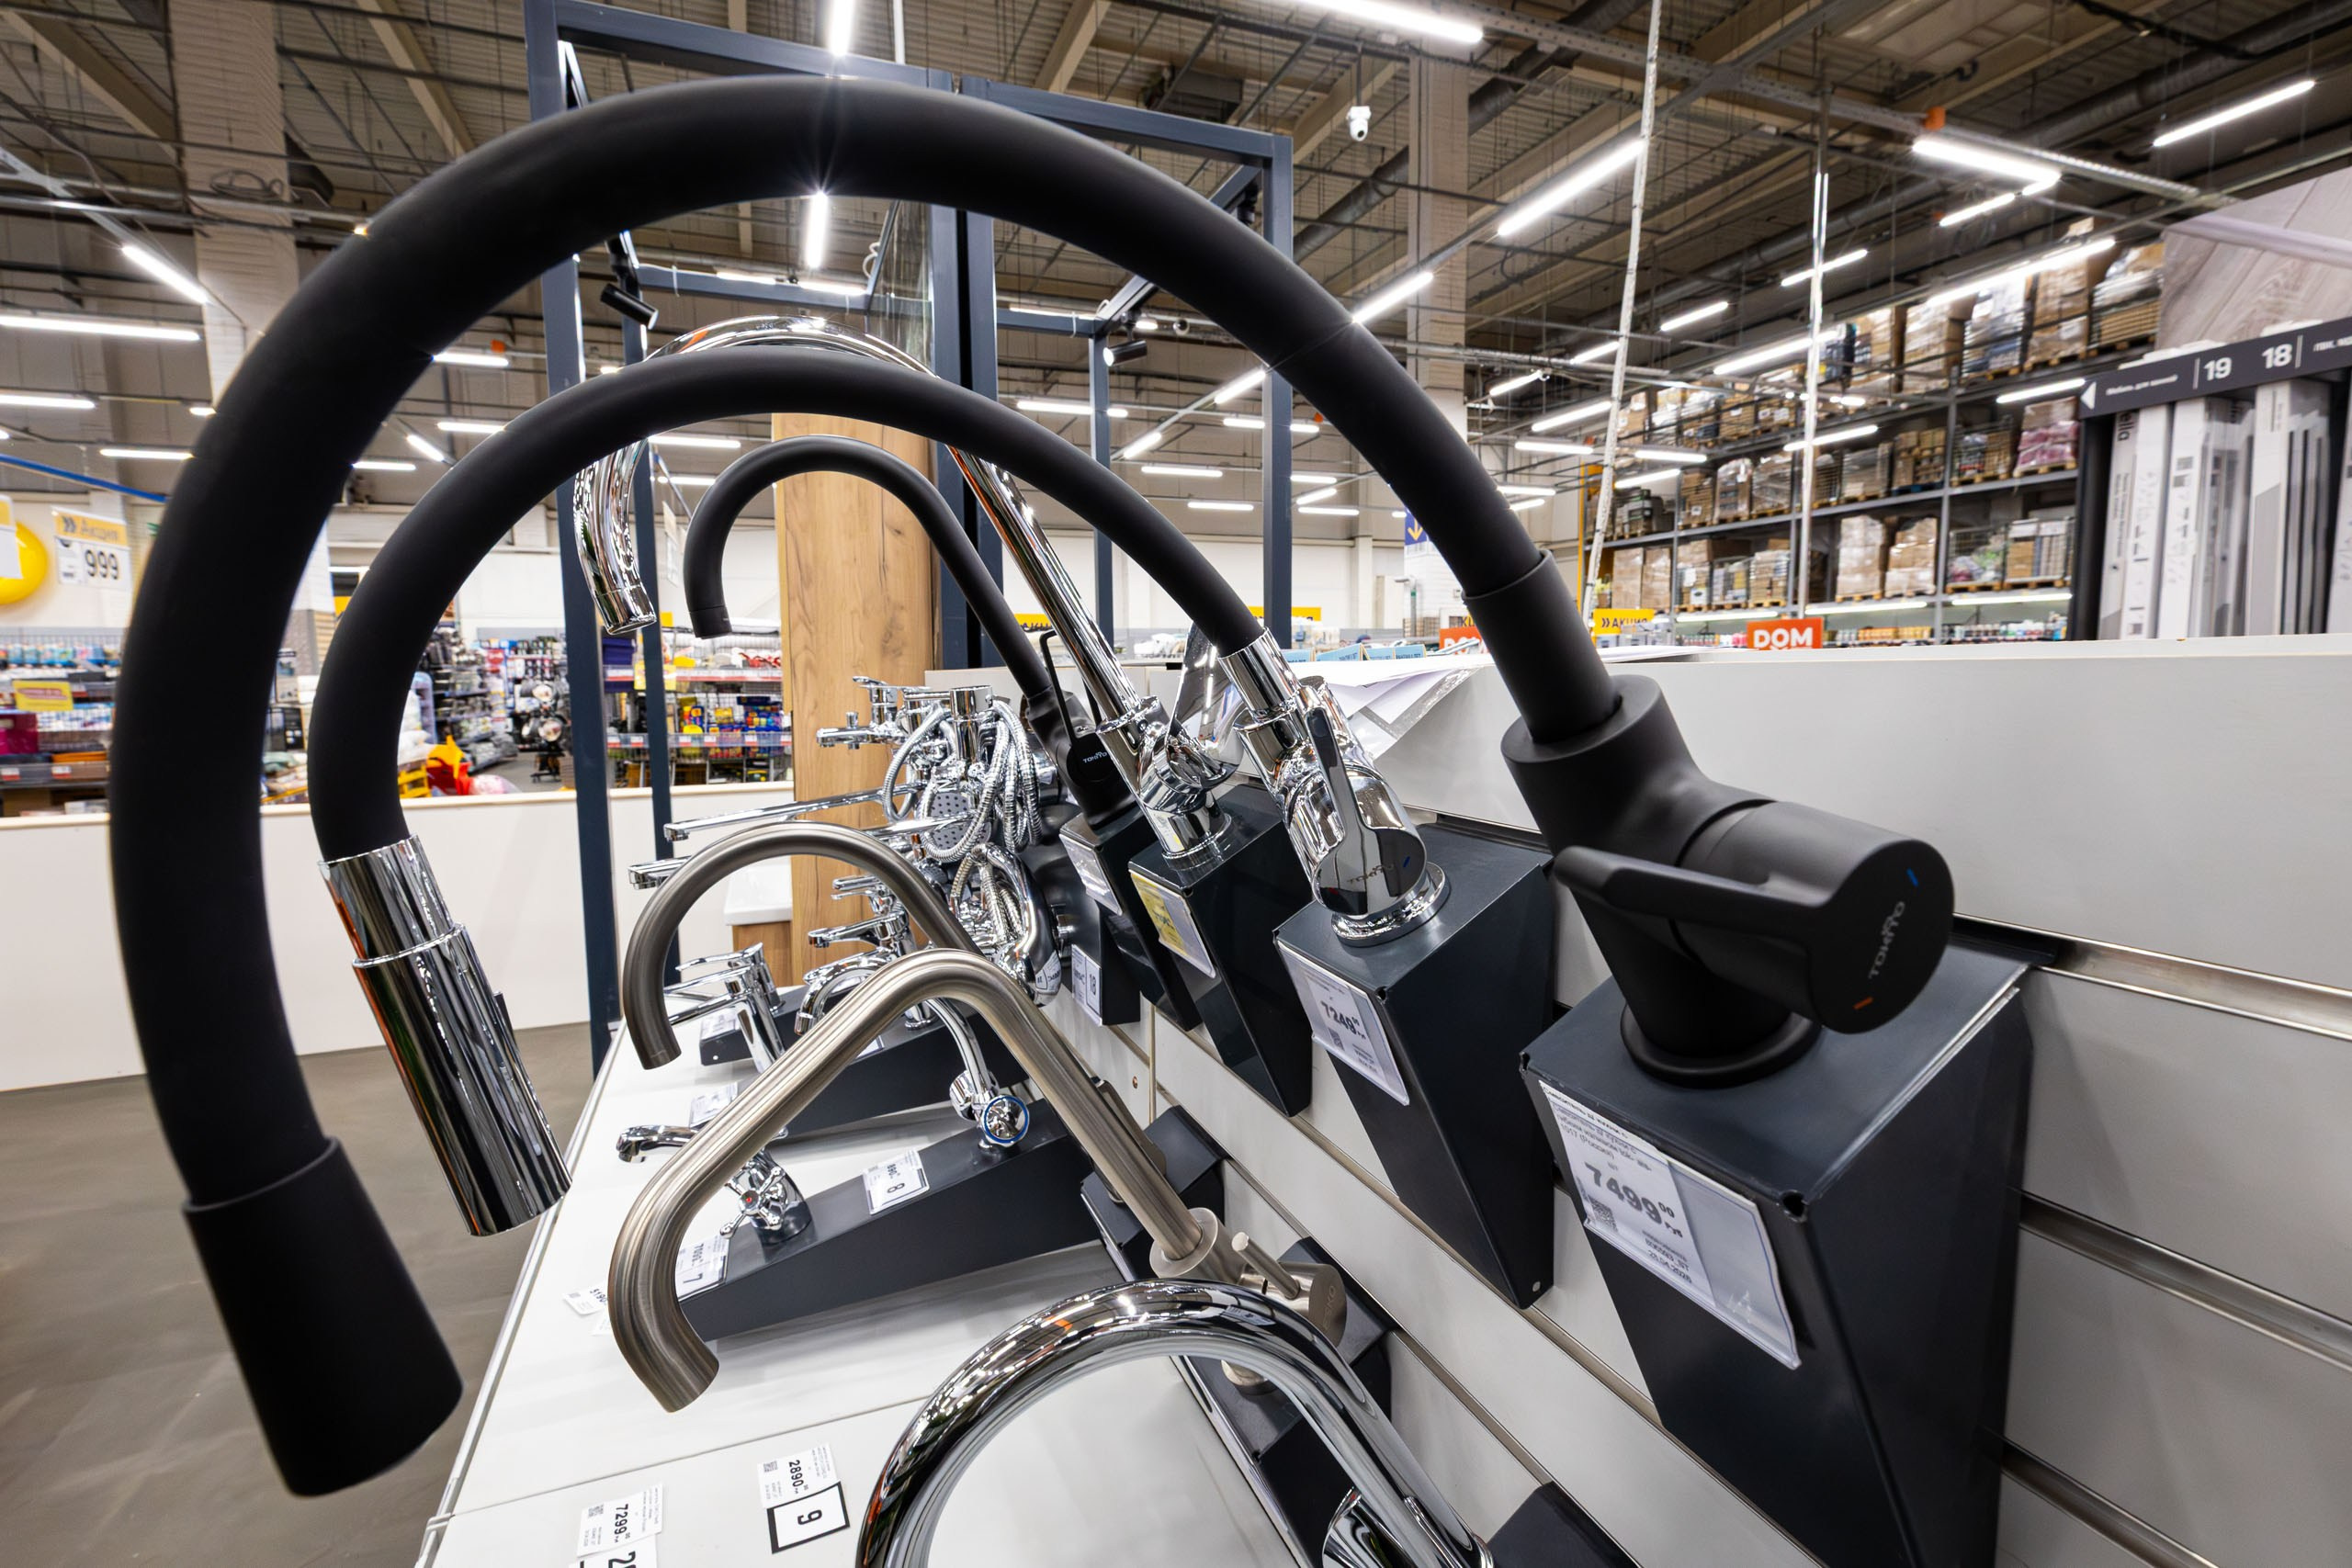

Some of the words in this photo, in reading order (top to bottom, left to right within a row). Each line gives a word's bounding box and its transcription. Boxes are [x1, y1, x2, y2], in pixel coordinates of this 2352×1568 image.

[2204, 356, 2233, 381] 19
[2262, 344, 2292, 369] 18
[85, 548, 119, 581] 999
[1754, 626, 1814, 649] DOM
[1320, 1000, 1357, 1036] 7249
[887, 1182, 905, 1193] 8
[1584, 1160, 1662, 1225] 7499
[1657, 1201, 1675, 1219] 00
[683, 1272, 703, 1284] 7
[788, 1459, 805, 1487] 2890
[614, 1503, 629, 1535] 7299
[797, 1508, 823, 1526] 9
